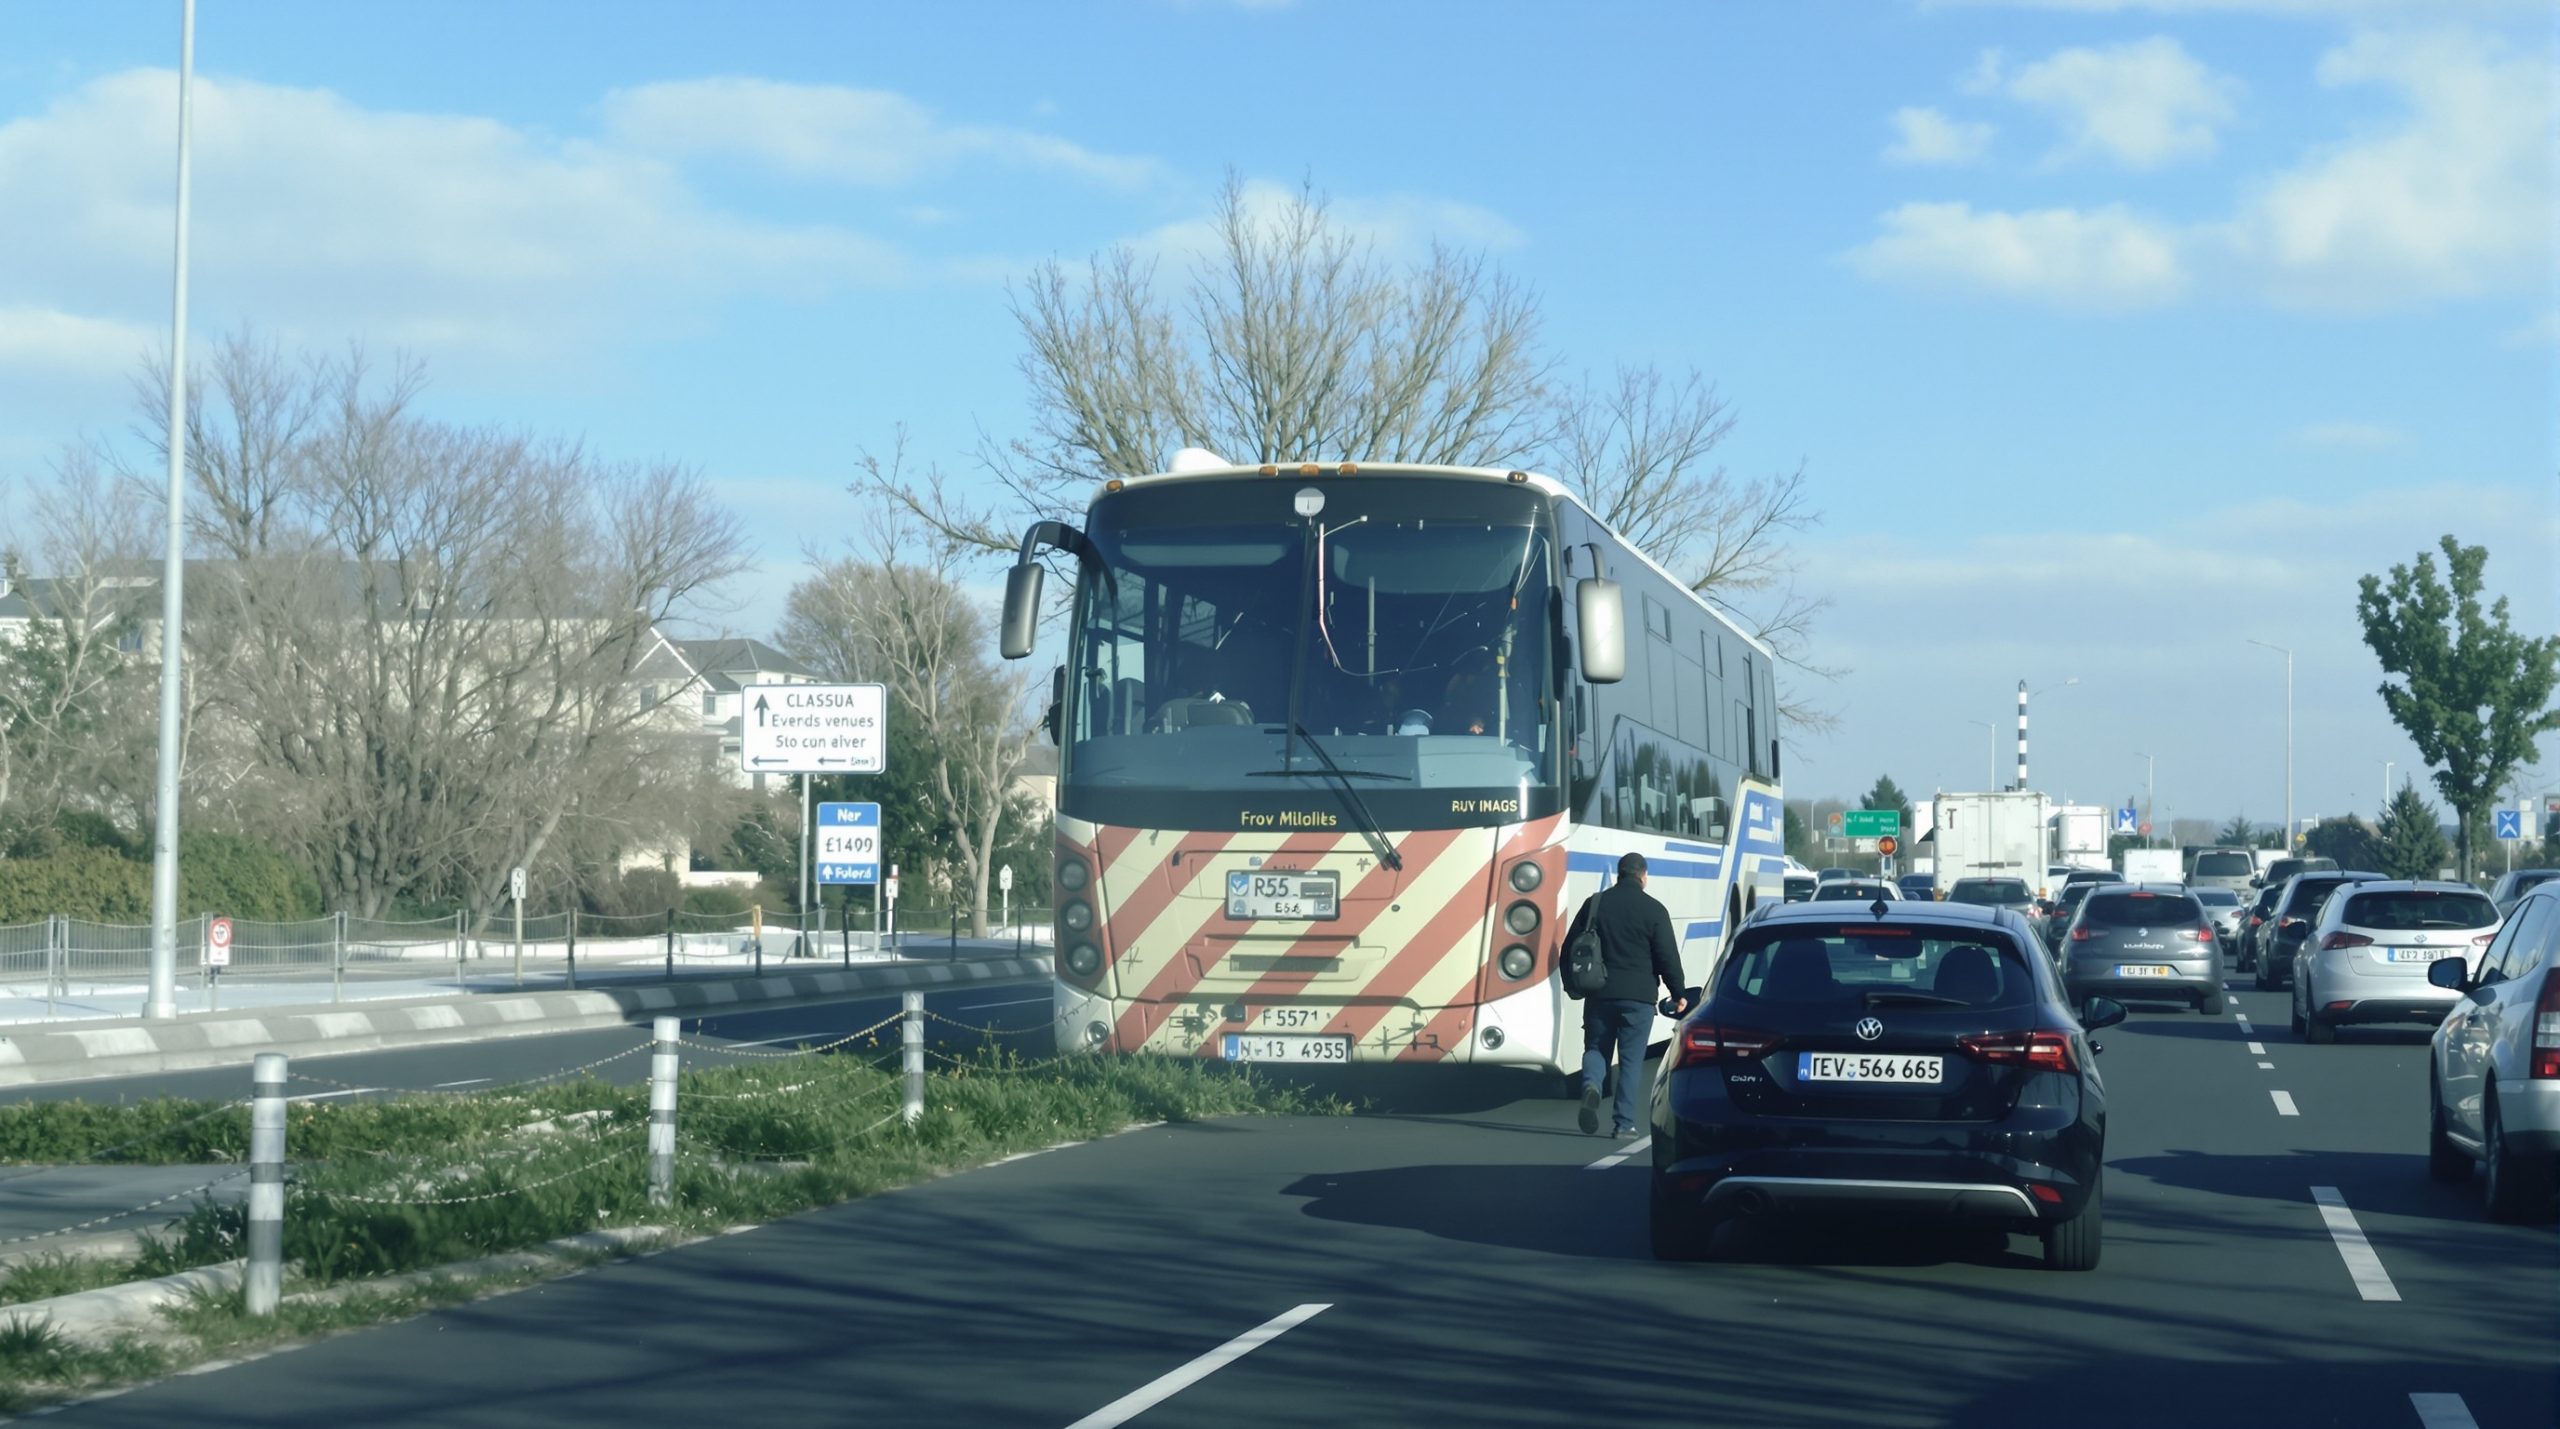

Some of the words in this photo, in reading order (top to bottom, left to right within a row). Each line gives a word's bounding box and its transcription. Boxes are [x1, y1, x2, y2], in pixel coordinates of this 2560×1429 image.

[786, 693, 854, 708] CLASSUA
[825, 716, 875, 728] venues
[1301, 1042, 1345, 1060] 4955
